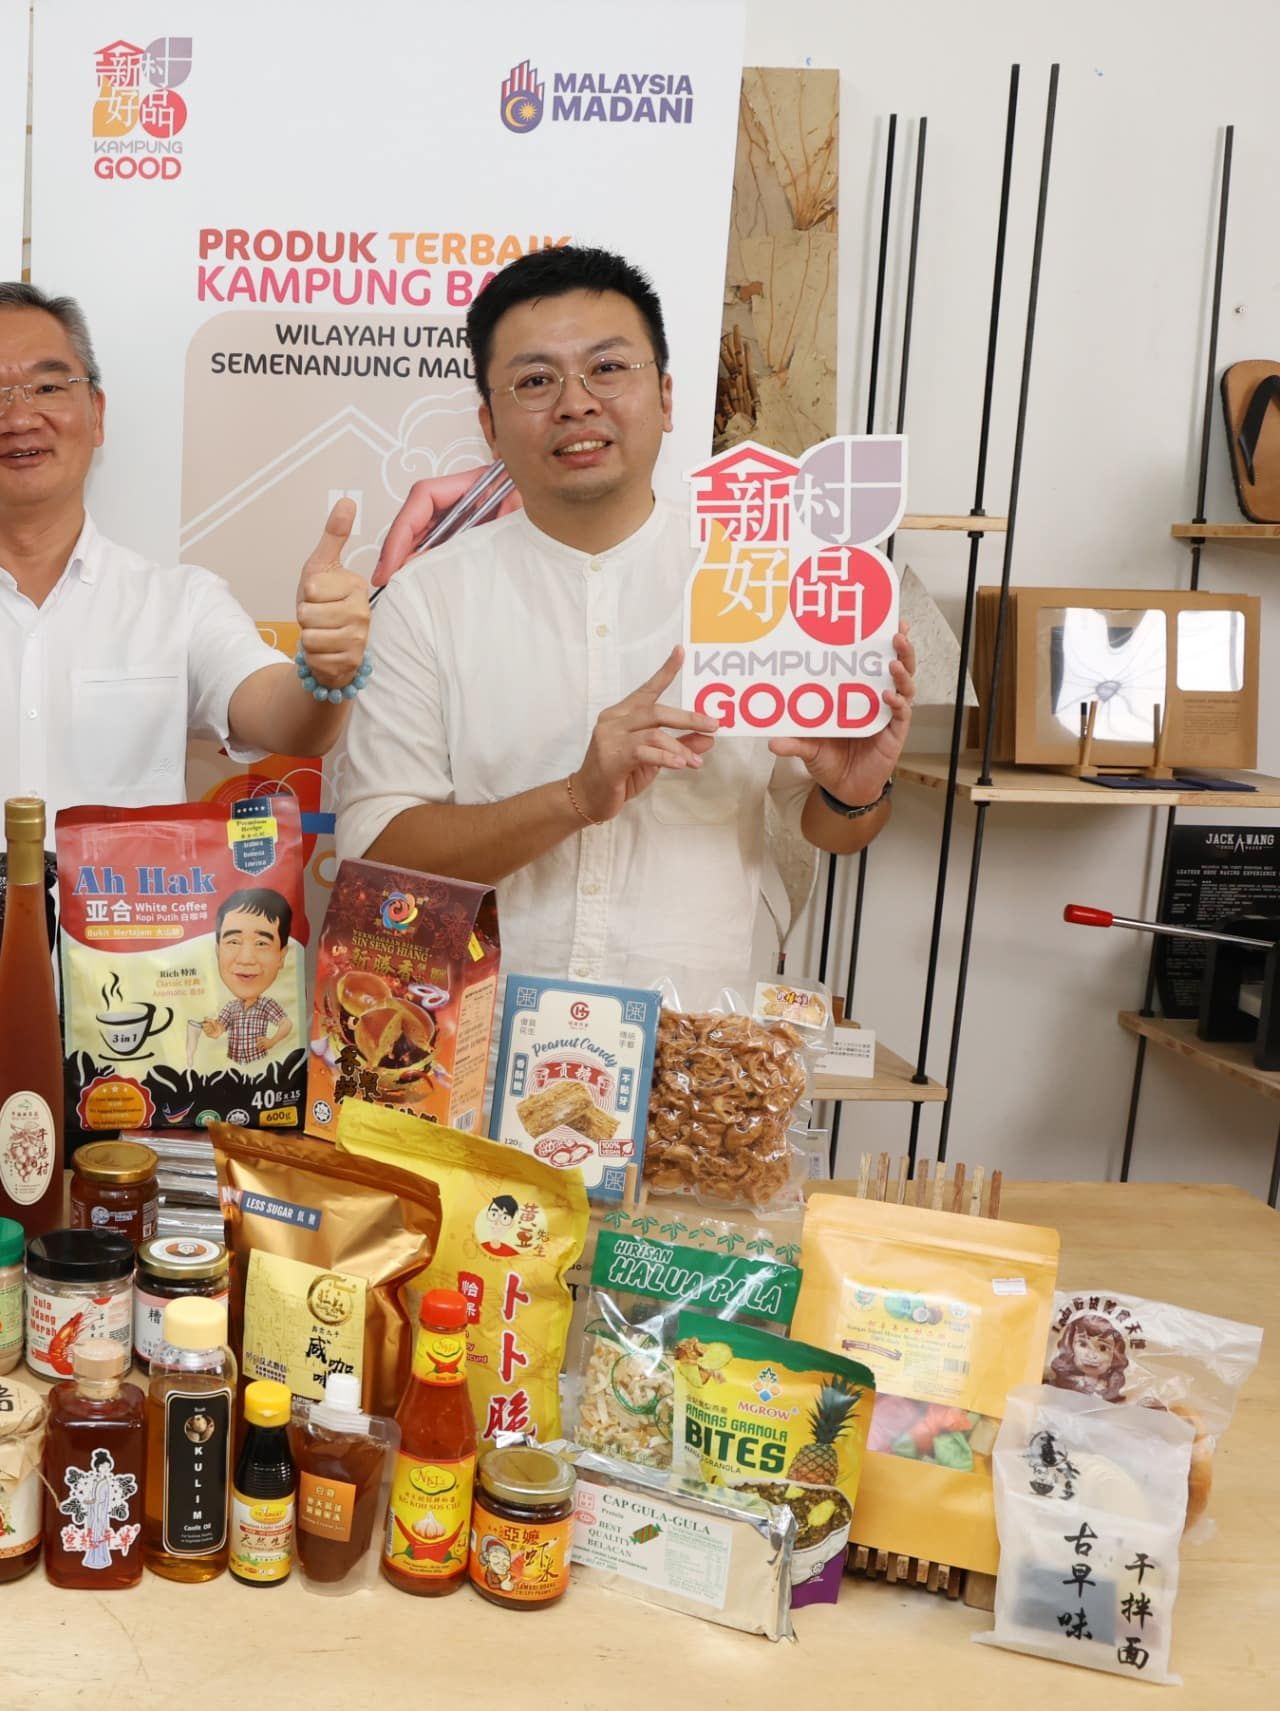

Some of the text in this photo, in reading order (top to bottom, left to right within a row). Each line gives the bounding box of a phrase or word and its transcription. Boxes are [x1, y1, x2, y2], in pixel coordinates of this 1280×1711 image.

[553, 72, 693, 96] MALAYSIA
[552, 94, 693, 124] MADANI
[94, 140, 183, 155] KAMPUNG
[94, 157, 182, 180] GOOD
[198, 228, 377, 263] PRODUK
[197, 265, 431, 306] KAMPUNG
[275, 323, 395, 347] WILAYAH
[211, 352, 410, 378] SEMENANJUNG
[694, 650, 882, 677] KAMPUNG
[694, 682, 880, 729] GOOD
[1205, 833, 1275, 846] JACK WANG
[72, 866, 216, 895] Ah Hak
[85, 900, 132, 922] 亚合
[135, 901, 208, 912] White Coffee
[135, 914, 154, 922] Kopi
[157, 913, 179, 921] Putih
[352, 935, 429, 961] SIN SENG HIANG
[160, 970, 179, 978] Rich
[120, 1033, 131, 1043] in
[532, 1038, 618, 1067] Peanut Candy
[246, 1196, 266, 1214] LESS
[266, 1201, 293, 1219] SUGAR
[614, 1240, 673, 1264] HIRISAN
[608, 1257, 782, 1314] HALUA PALA
[33, 1296, 51, 1310] Gula
[30, 1319, 57, 1336] Merah
[31, 1307, 56, 1325] Udang
[686, 1403, 788, 1443] ANANAS GRANOLA
[738, 1401, 790, 1421] MGROW
[686, 1416, 786, 1474] BITES
[193, 1446, 203, 1520] KULIM
[599, 1520, 622, 1533] BEST
[602, 1494, 711, 1535] CAP GULA-GULA
[587, 1538, 632, 1558] BELACAN
[588, 1528, 631, 1546] QUALITY
[1056, 1521, 1101, 1642] 古早味
[1116, 1552, 1157, 1671] 干拌面
